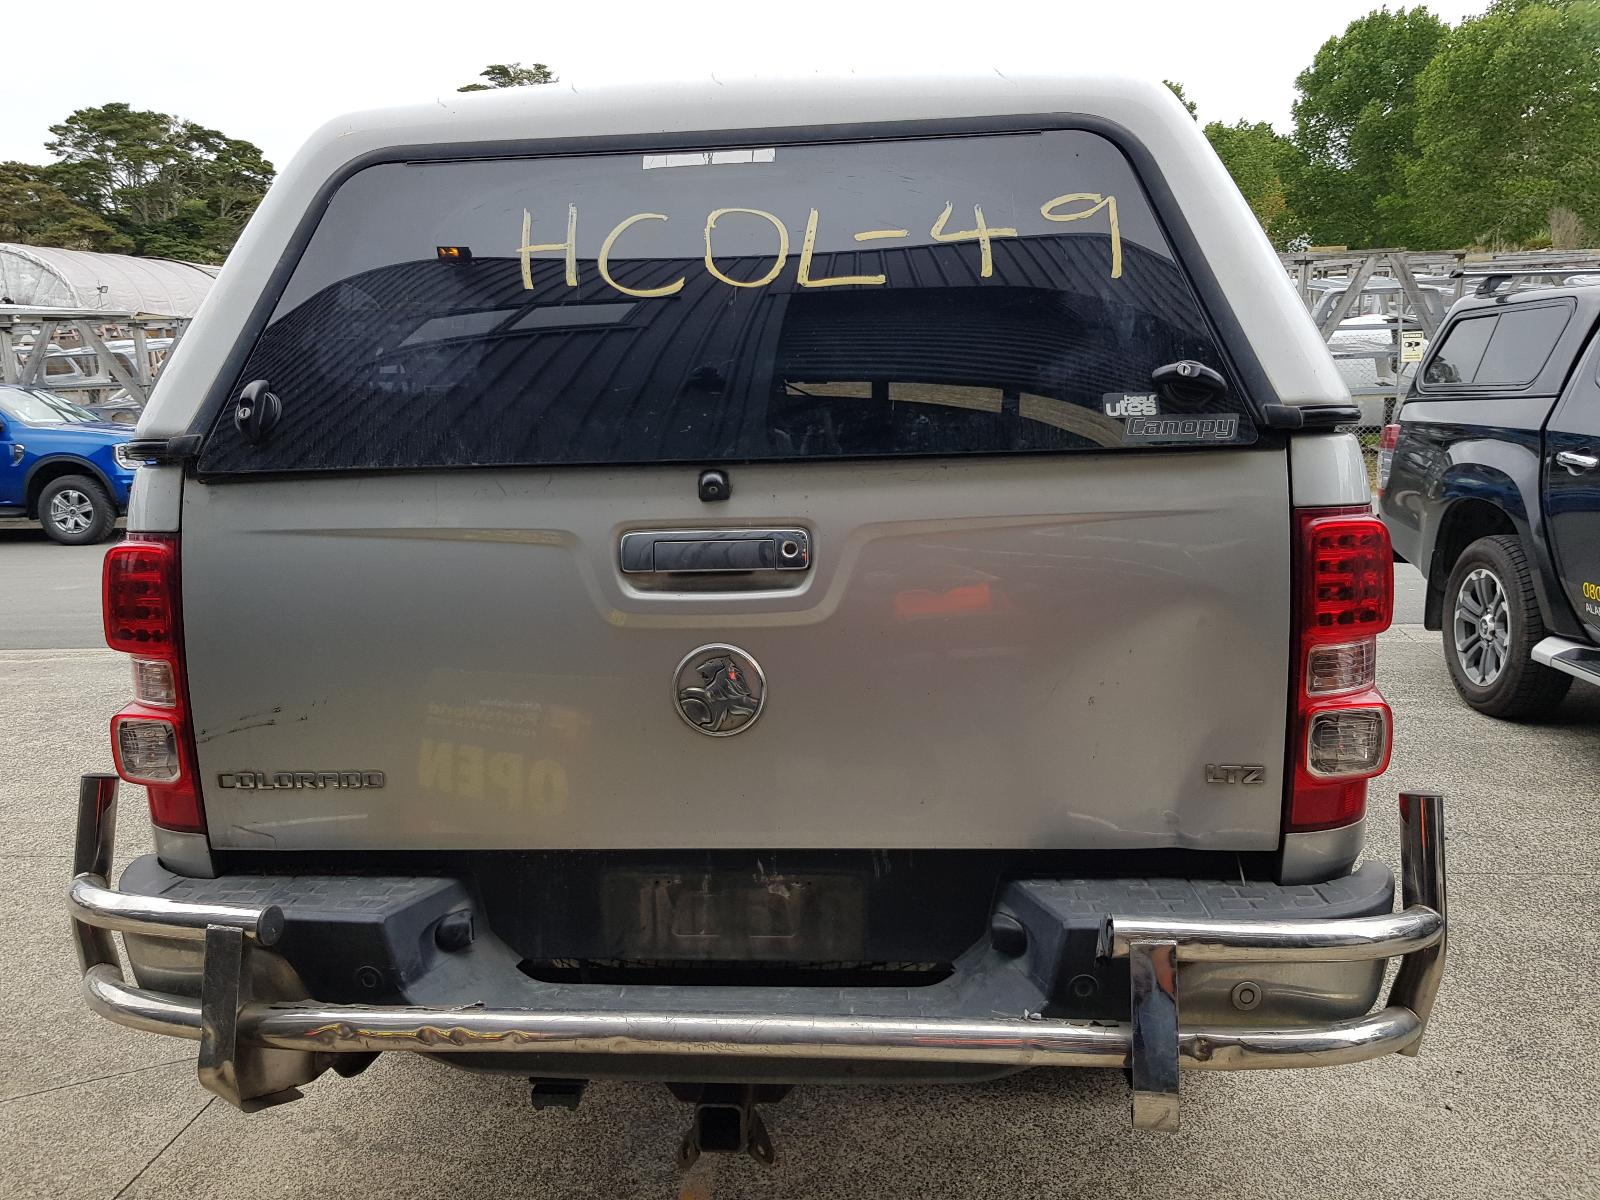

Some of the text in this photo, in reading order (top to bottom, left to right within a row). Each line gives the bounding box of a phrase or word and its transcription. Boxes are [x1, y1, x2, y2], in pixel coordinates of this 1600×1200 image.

[516, 193, 1122, 297] HCOL-49
[1127, 417, 1236, 438] Canopy
[217, 771, 385, 790] COLORADO
[1205, 764, 1265, 784] LTZ
